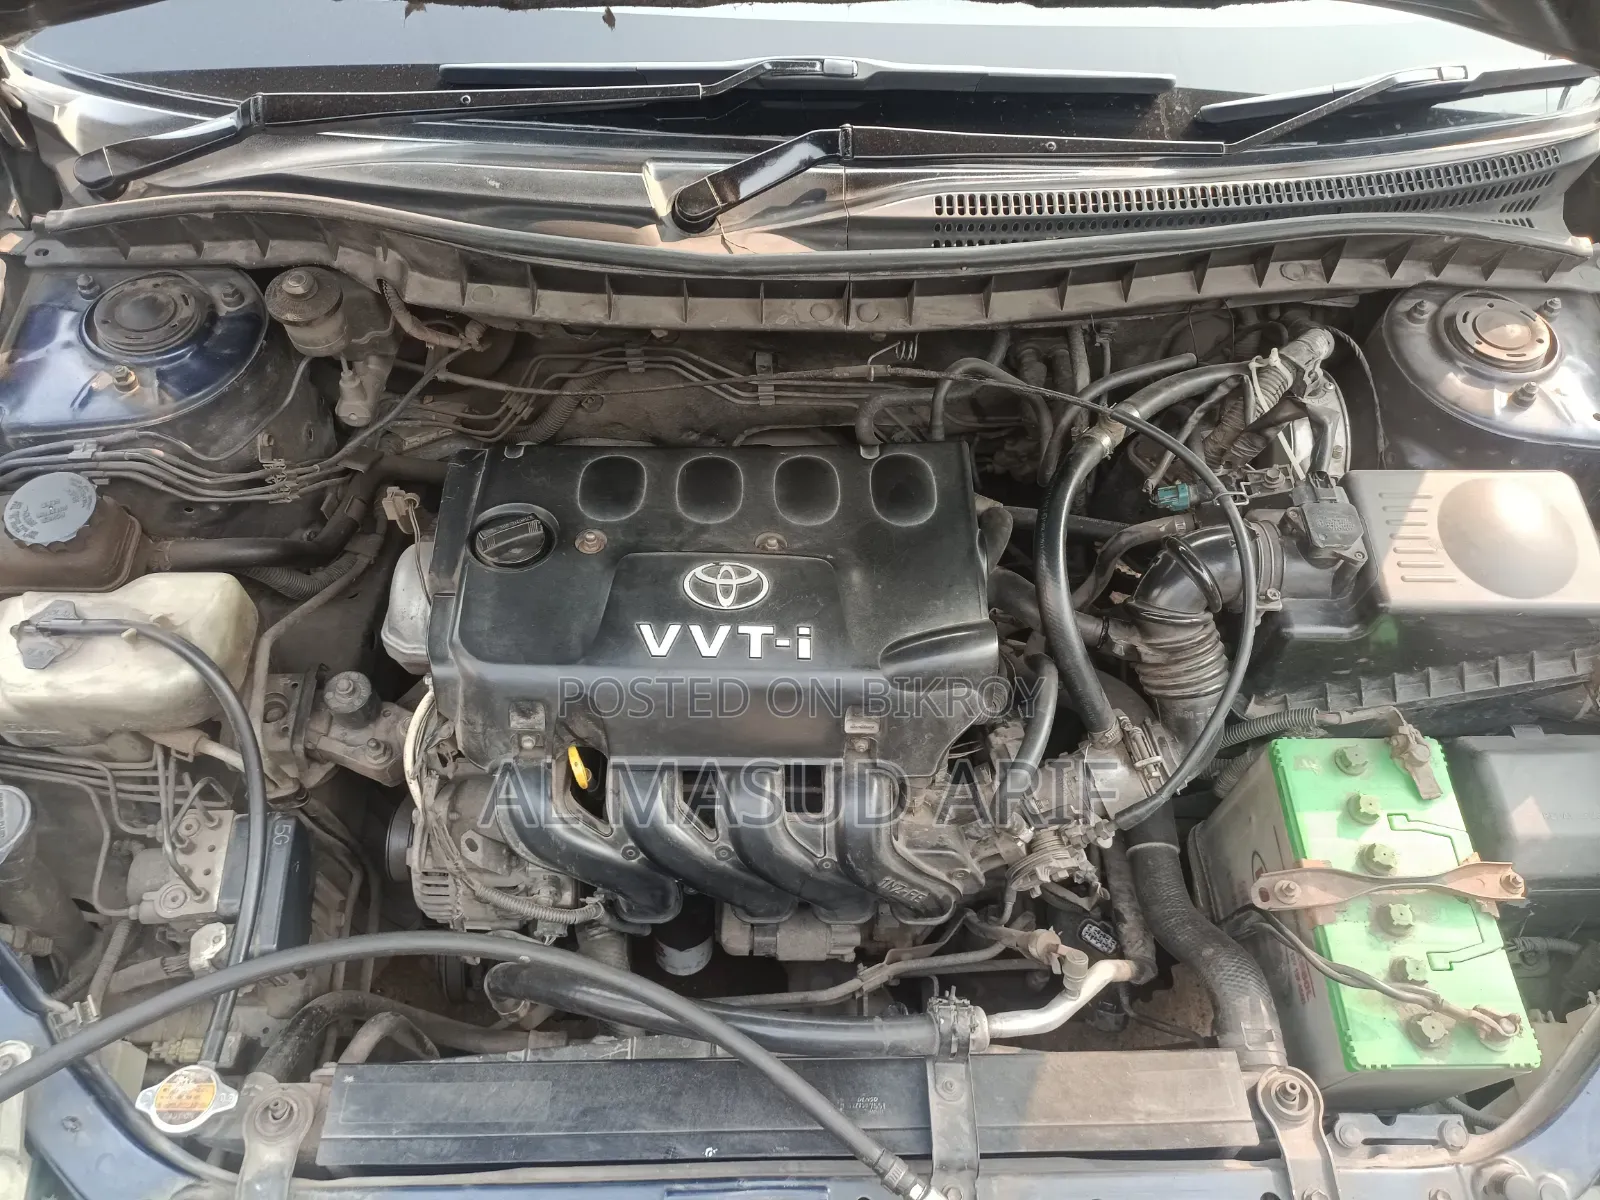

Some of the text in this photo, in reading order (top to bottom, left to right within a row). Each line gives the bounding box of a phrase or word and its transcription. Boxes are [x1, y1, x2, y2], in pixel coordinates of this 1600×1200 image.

[636, 623, 812, 660] VVT-i
[272, 824, 292, 846] 5G
[877, 876, 928, 903] 1NZ-FE
